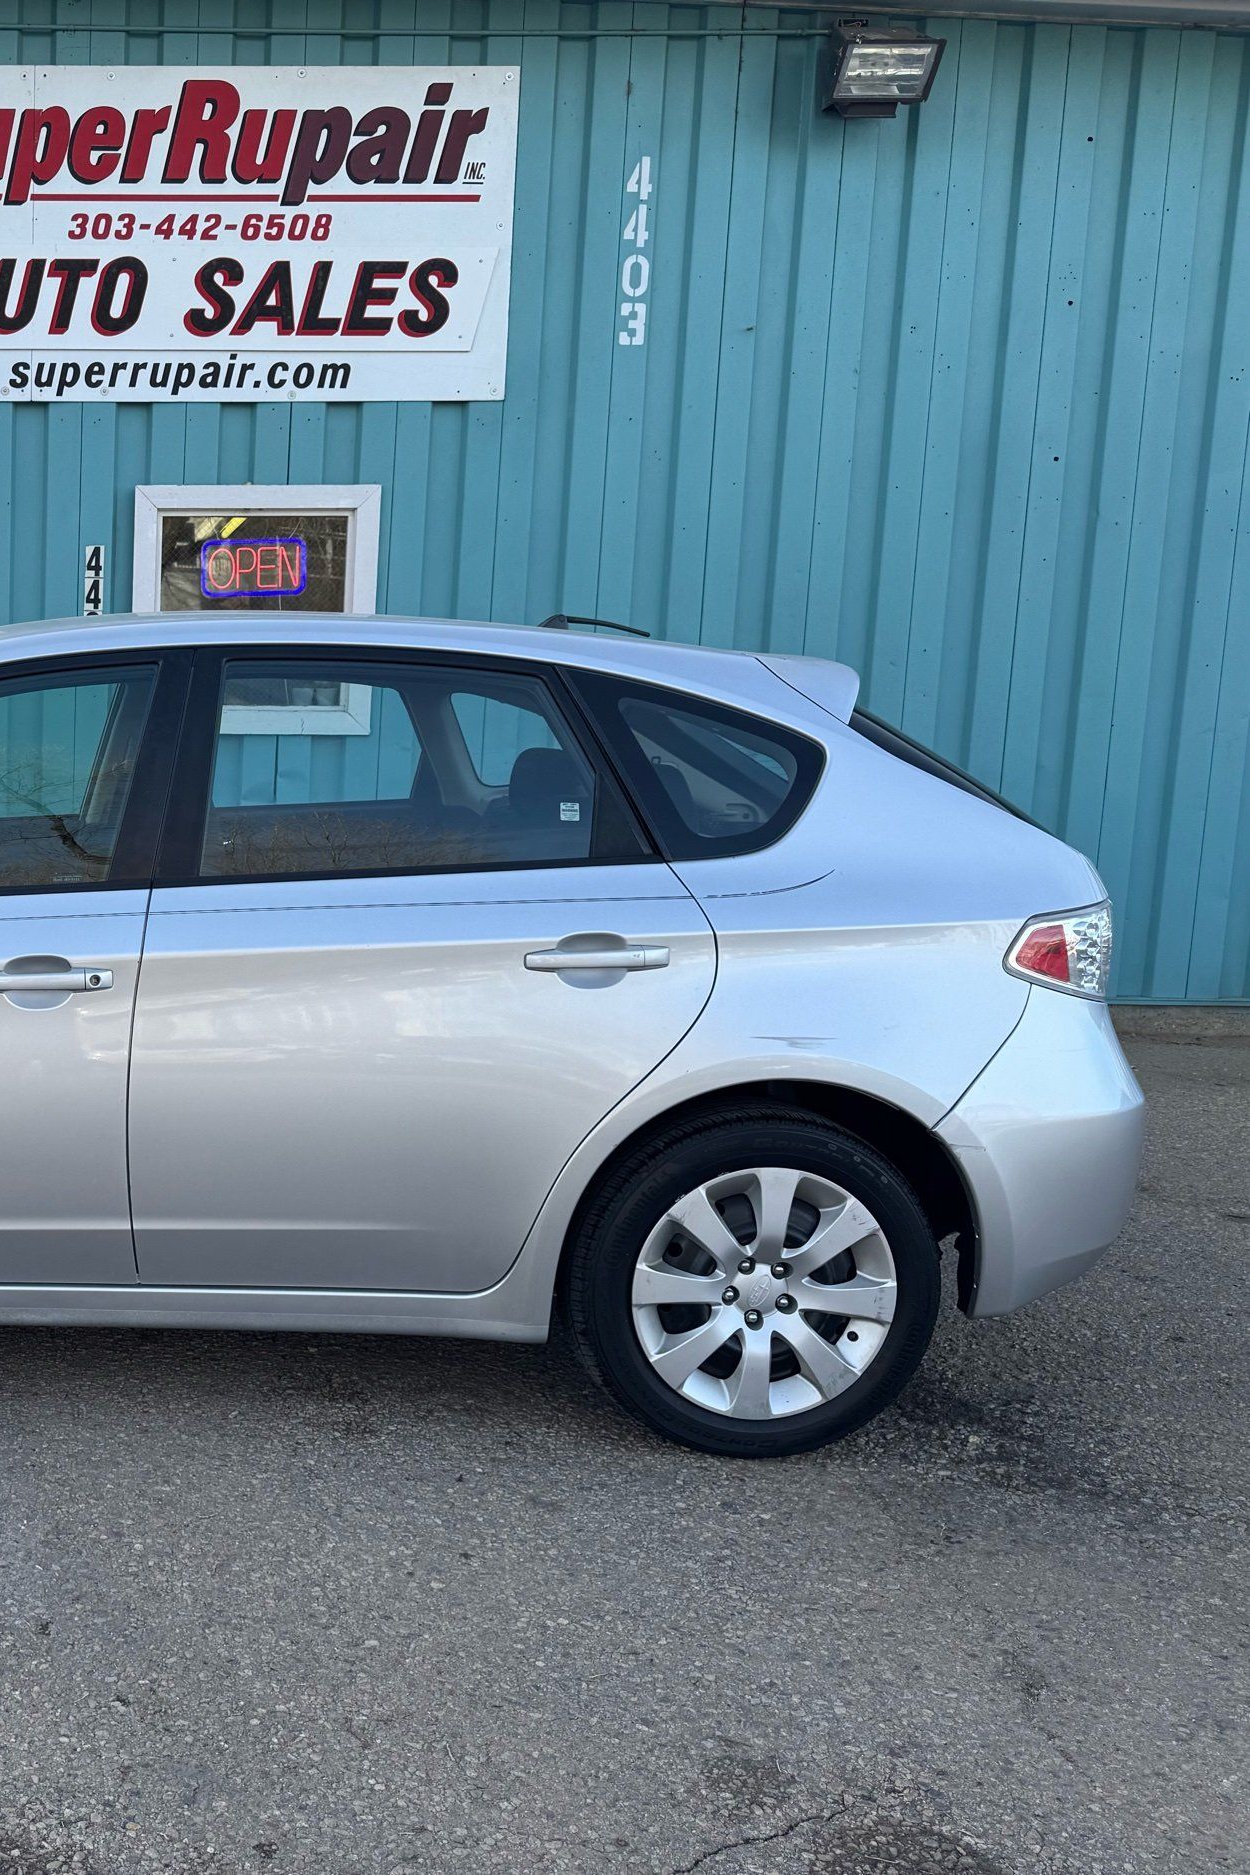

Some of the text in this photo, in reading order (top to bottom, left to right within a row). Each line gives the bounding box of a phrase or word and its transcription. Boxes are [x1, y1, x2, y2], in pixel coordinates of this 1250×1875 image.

[463, 161, 486, 180] INC.
[68, 213, 333, 241] 303-442-6508
[618, 156, 653, 346] 4403
[183, 256, 459, 339] SALES
[8, 353, 351, 394] superrupair.com
[85, 546, 102, 616] 44
[208, 545, 300, 590] OPEN
